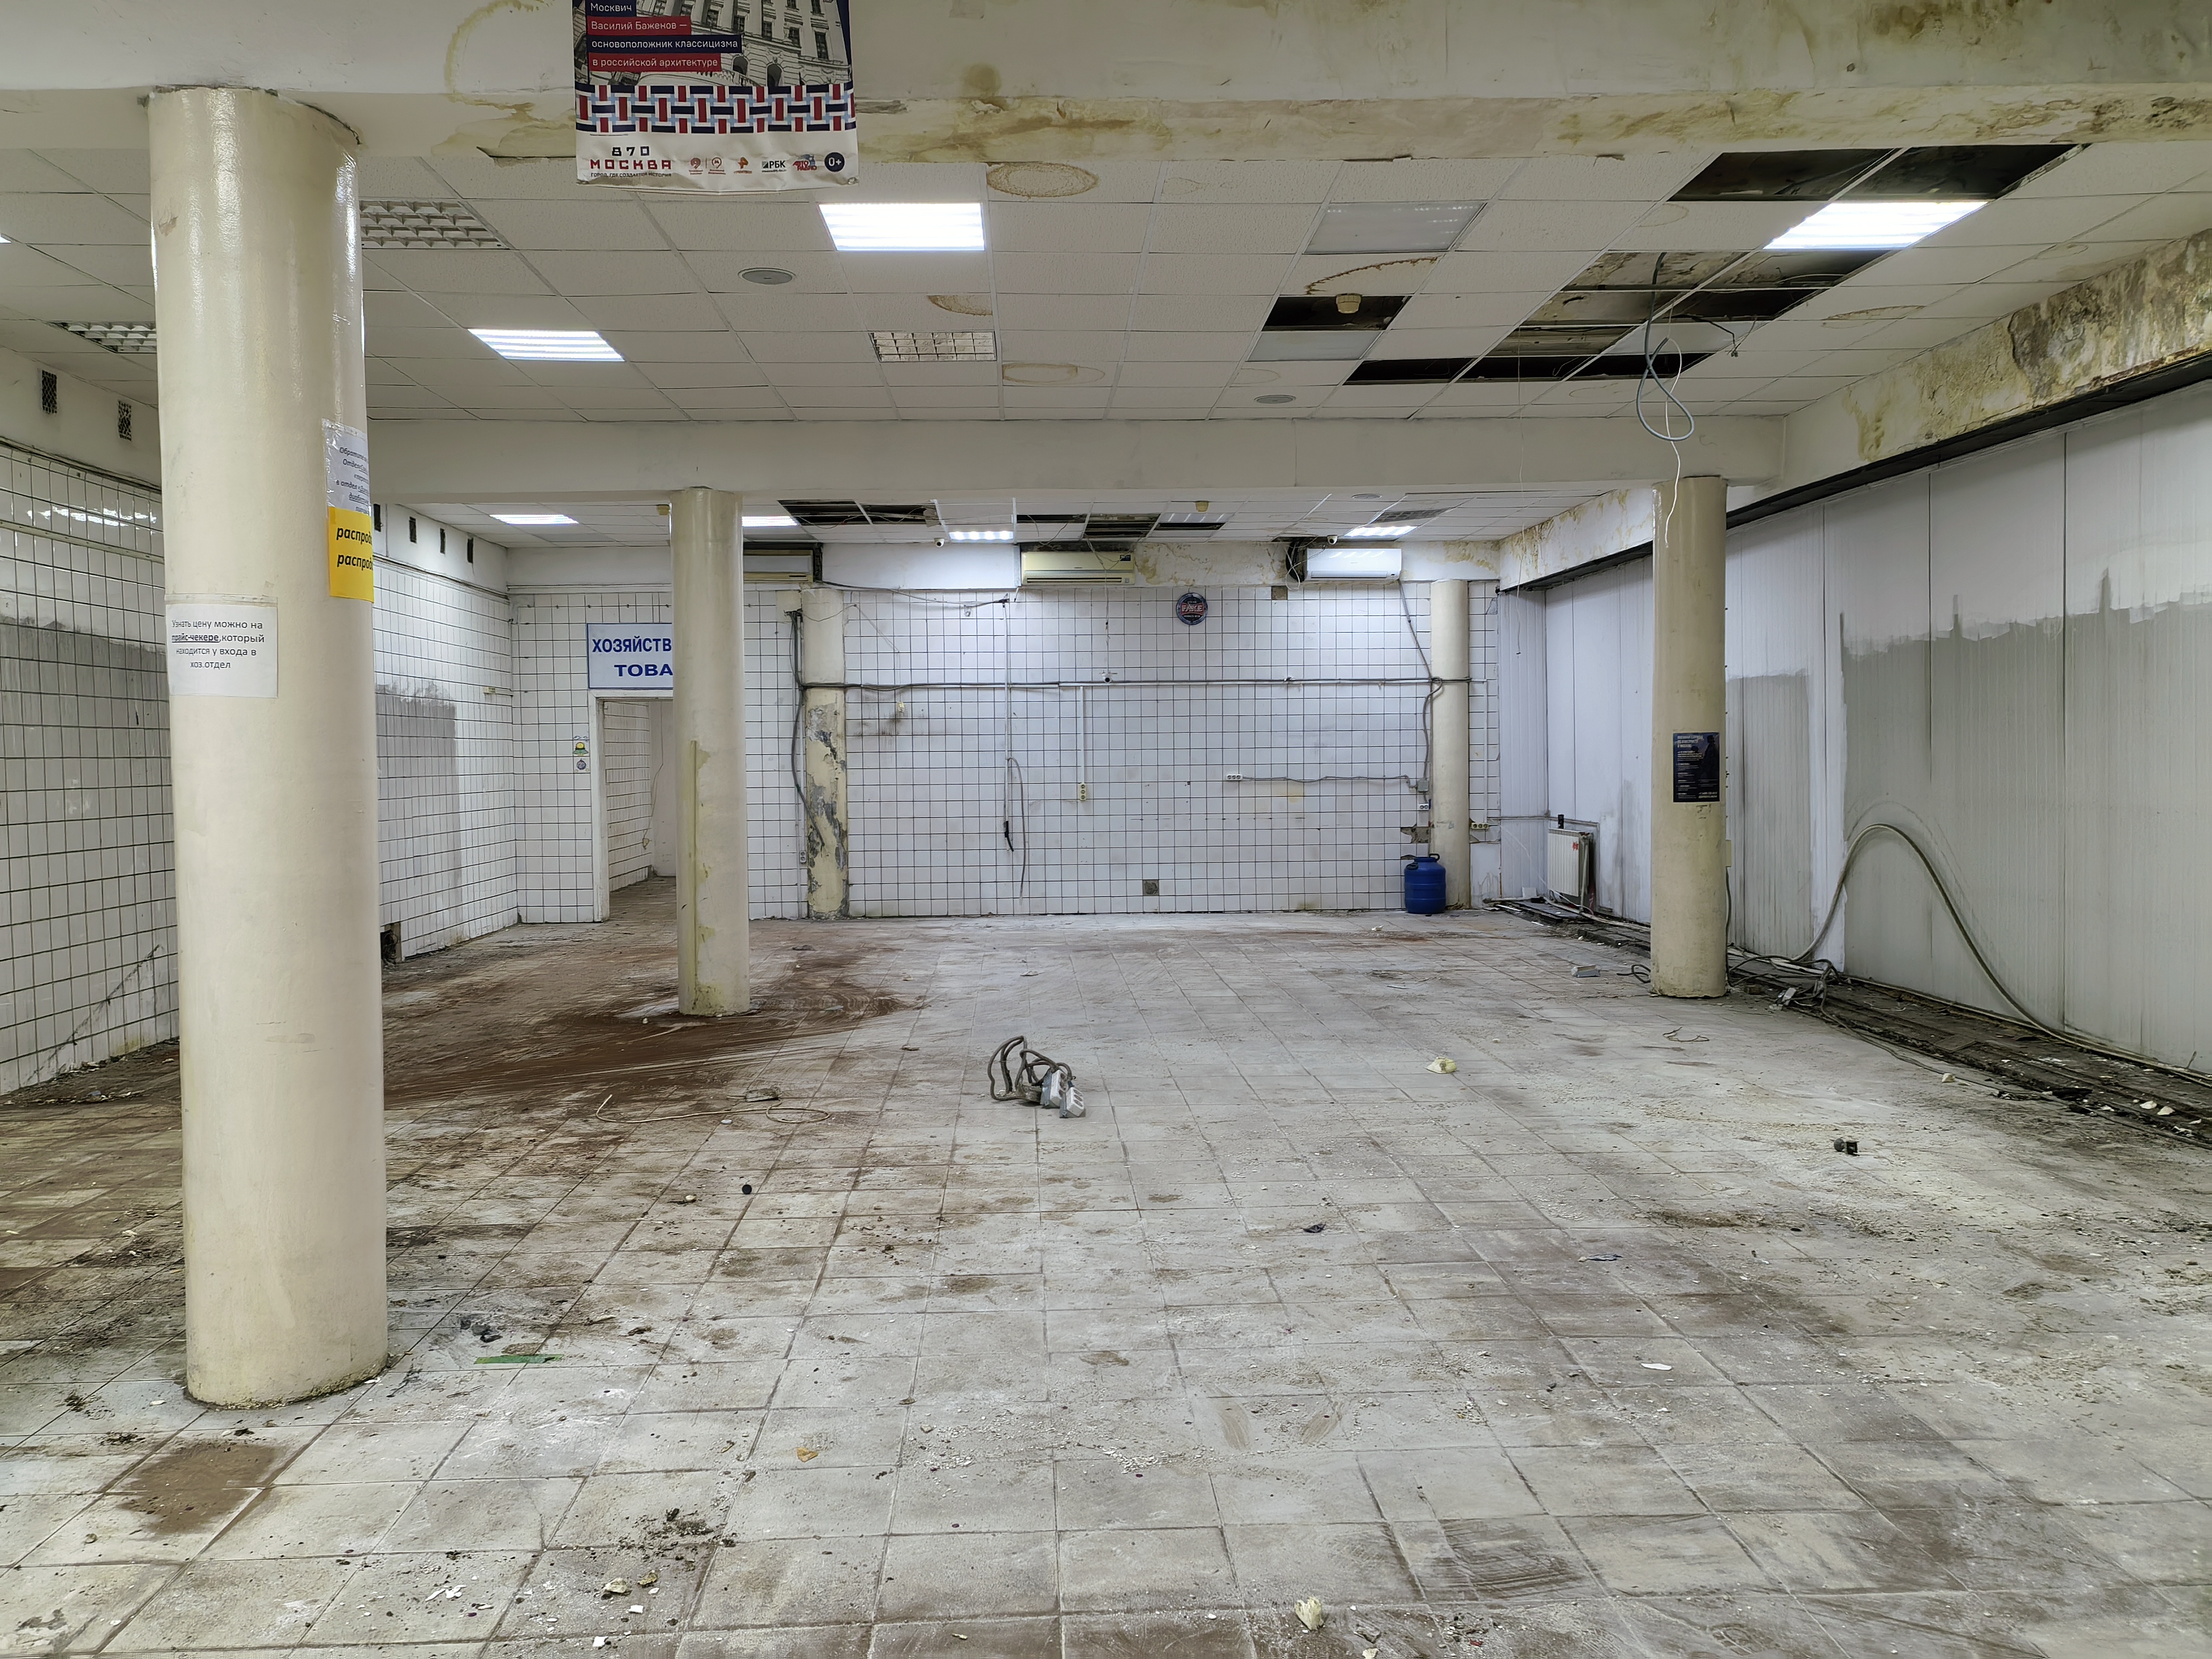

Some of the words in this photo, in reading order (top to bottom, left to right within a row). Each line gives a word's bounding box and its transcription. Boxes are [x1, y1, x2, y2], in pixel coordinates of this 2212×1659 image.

[591, 3, 632, 12] Москвич
[591, 21, 632, 30] Василий
[635, 22, 677, 30] Баженов
[592, 41, 673, 49] основоположник
[675, 40, 738, 48] классицизма
[601, 58, 657, 67] российской
[659, 59, 718, 67] архитектуре
[612, 146, 650, 156] 870
[590, 159, 671, 170] МОСКВА
[769, 160, 786, 168] РБК
[828, 157, 842, 166] 0+
[193, 621, 212, 629] цену
[592, 635, 672, 652] ХОЗЯЙСТВ
[212, 648, 217, 656] у
[219, 649, 248, 657] входа
[614, 664, 673, 677] ТОВА
